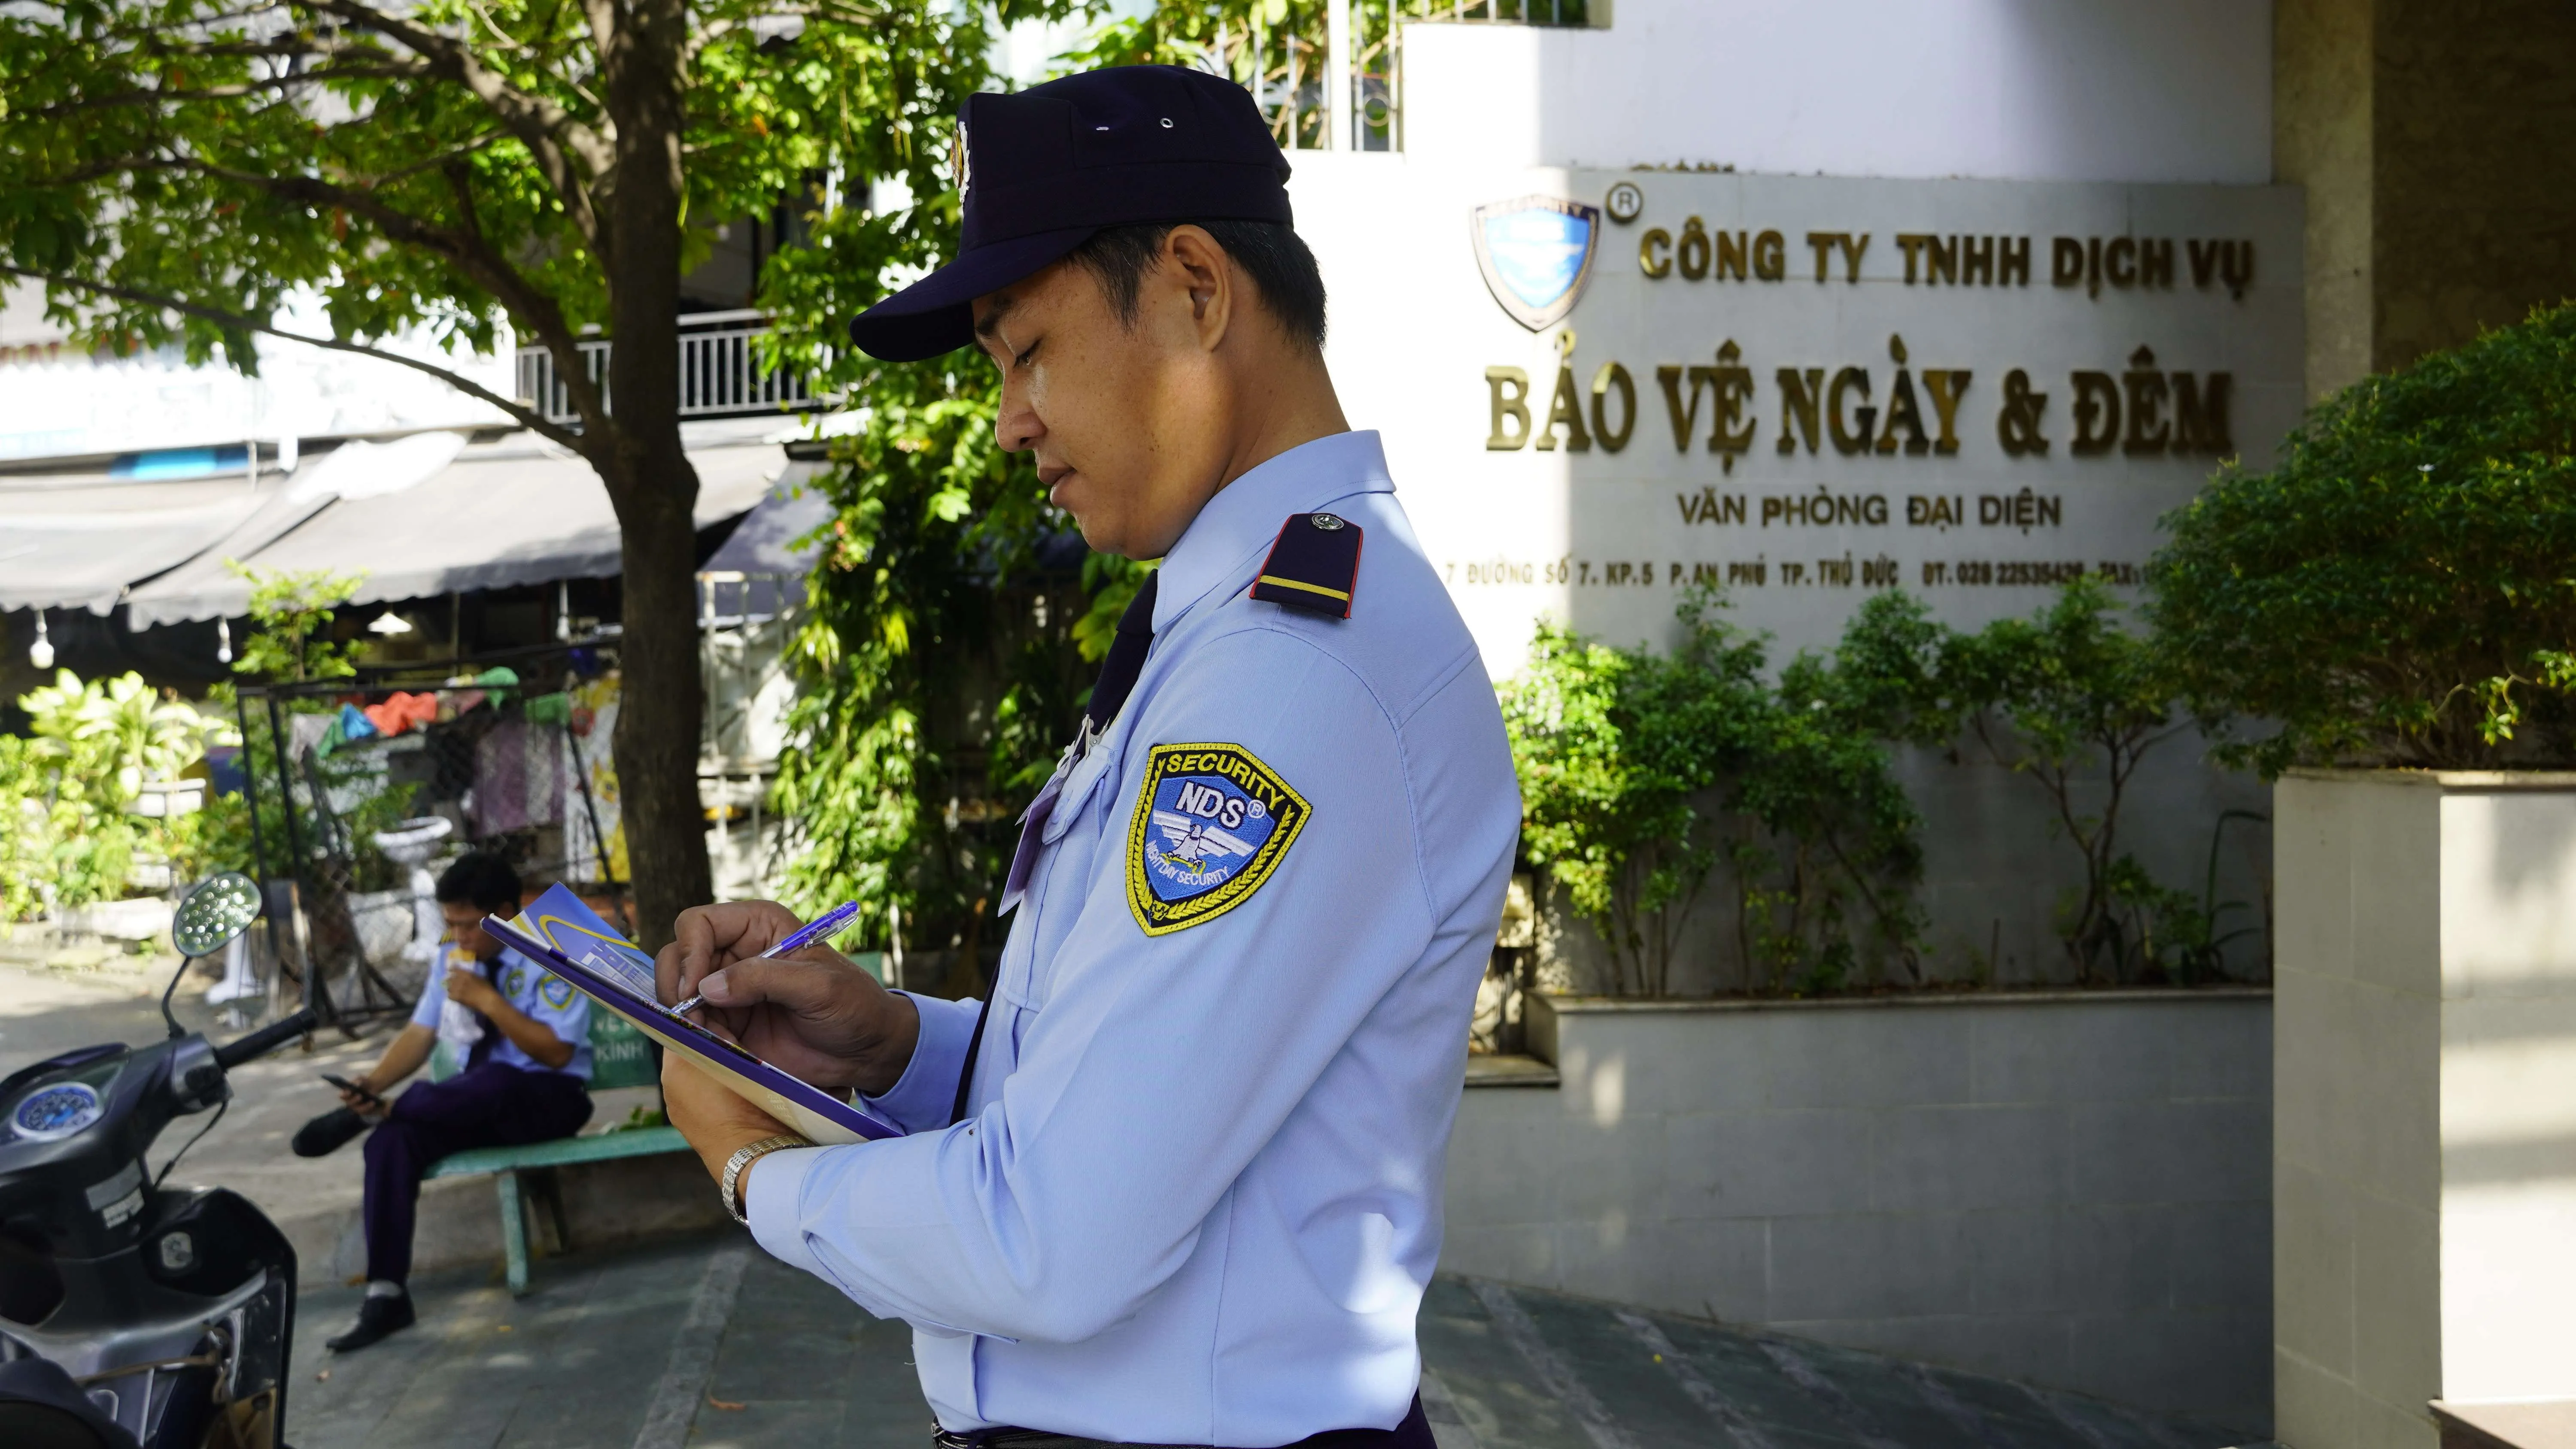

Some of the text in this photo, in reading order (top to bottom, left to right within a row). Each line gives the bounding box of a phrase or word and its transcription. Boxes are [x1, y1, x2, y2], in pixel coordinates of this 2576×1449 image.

[1639, 215, 2257, 302] CÔNG TY TNHH DỊCH VỤ
[1485, 330, 2233, 475] BẢO VỆ NGÀY & ĐÊM
[1677, 485, 2062, 536] VĂN PHÒNG ĐẠI DIỆN
[1545, 552, 1573, 583] SỐ
[1166, 753, 1285, 811] SECURITY
[1158, 863, 1180, 879] DAY
[1177, 866, 1230, 885] SECURITY
